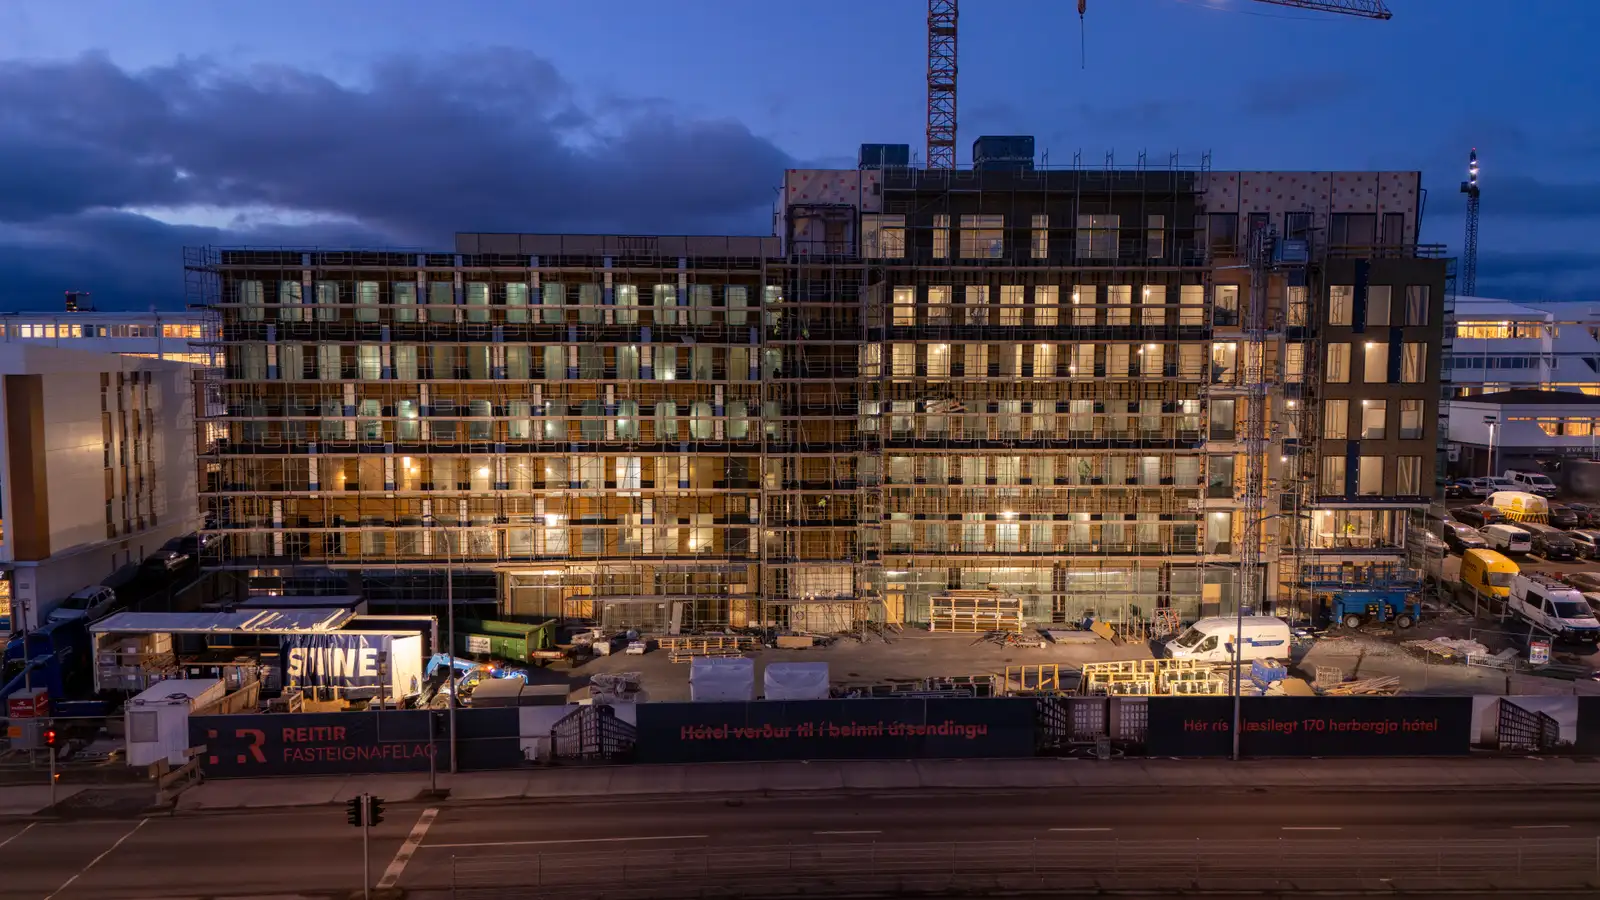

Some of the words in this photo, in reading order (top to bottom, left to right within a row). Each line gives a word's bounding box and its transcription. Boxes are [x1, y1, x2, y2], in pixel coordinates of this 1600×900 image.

[282, 725, 347, 742] REITIR
[680, 723, 729, 740] Hótel
[734, 722, 792, 739] verður
[797, 722, 814, 737] til
[819, 720, 825, 737] í
[829, 721, 883, 737] beinni
[888, 720, 988, 740] útsendingu
[1183, 718, 1208, 732] Hér
[1212, 718, 1229, 732] rís
[1238, 718, 1298, 735] læsilegt
[1302, 719, 1326, 732] 170
[1329, 718, 1398, 735] herbergja
[1402, 717, 1438, 732] hótel
